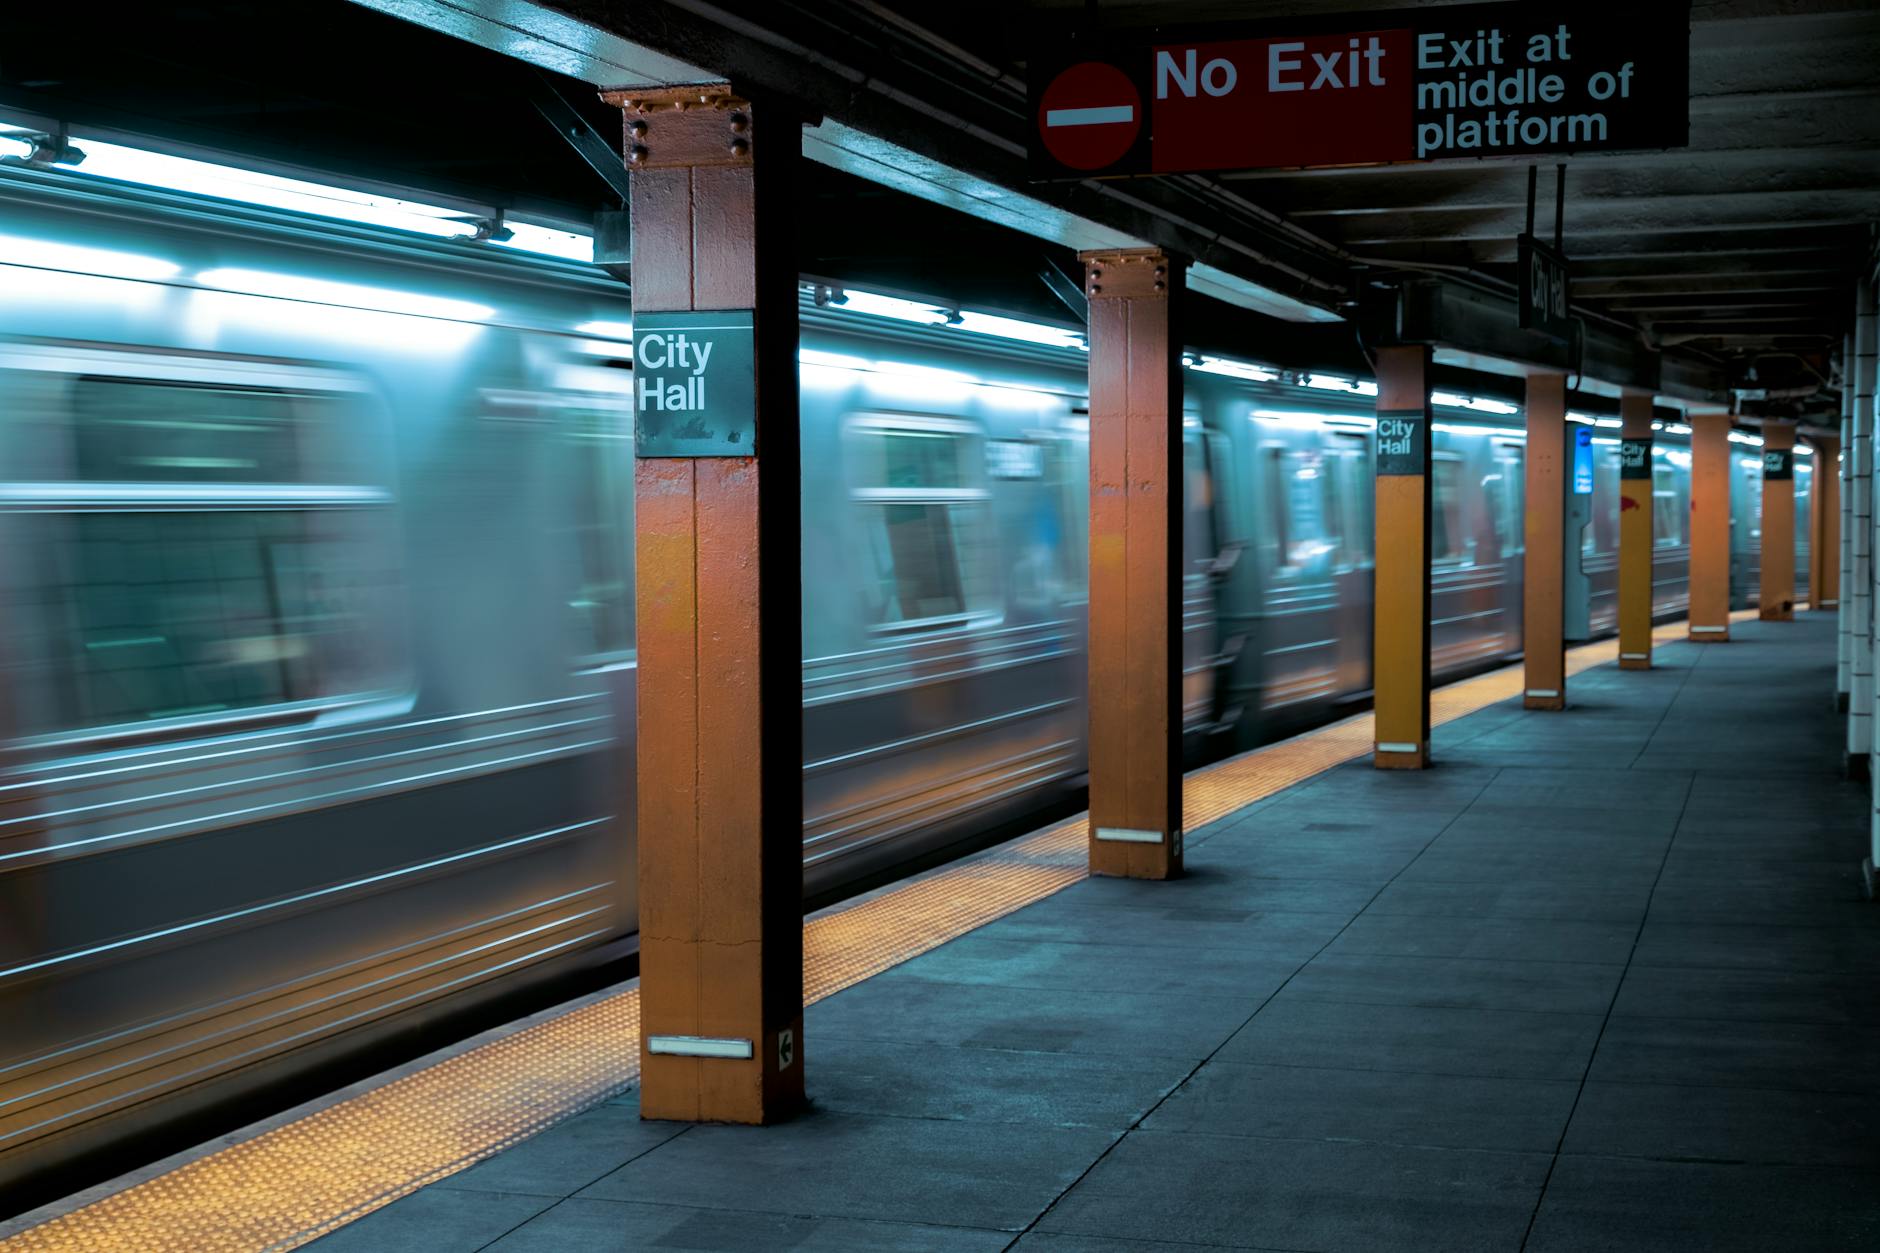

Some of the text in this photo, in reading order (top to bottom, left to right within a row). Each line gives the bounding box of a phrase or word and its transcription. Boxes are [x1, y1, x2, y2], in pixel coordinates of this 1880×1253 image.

[1419, 24, 1571, 69] Exit at
[1157, 37, 1387, 100] No Exit
[1418, 62, 1635, 110] middle of
[1418, 110, 1608, 158] platform
[638, 333, 713, 376] City
[638, 376, 705, 411] Hall
[1378, 419, 1415, 439] City
[1378, 438, 1411, 455] Hall
[1622, 442, 1647, 457] City
[1622, 455, 1644, 468] Hall
